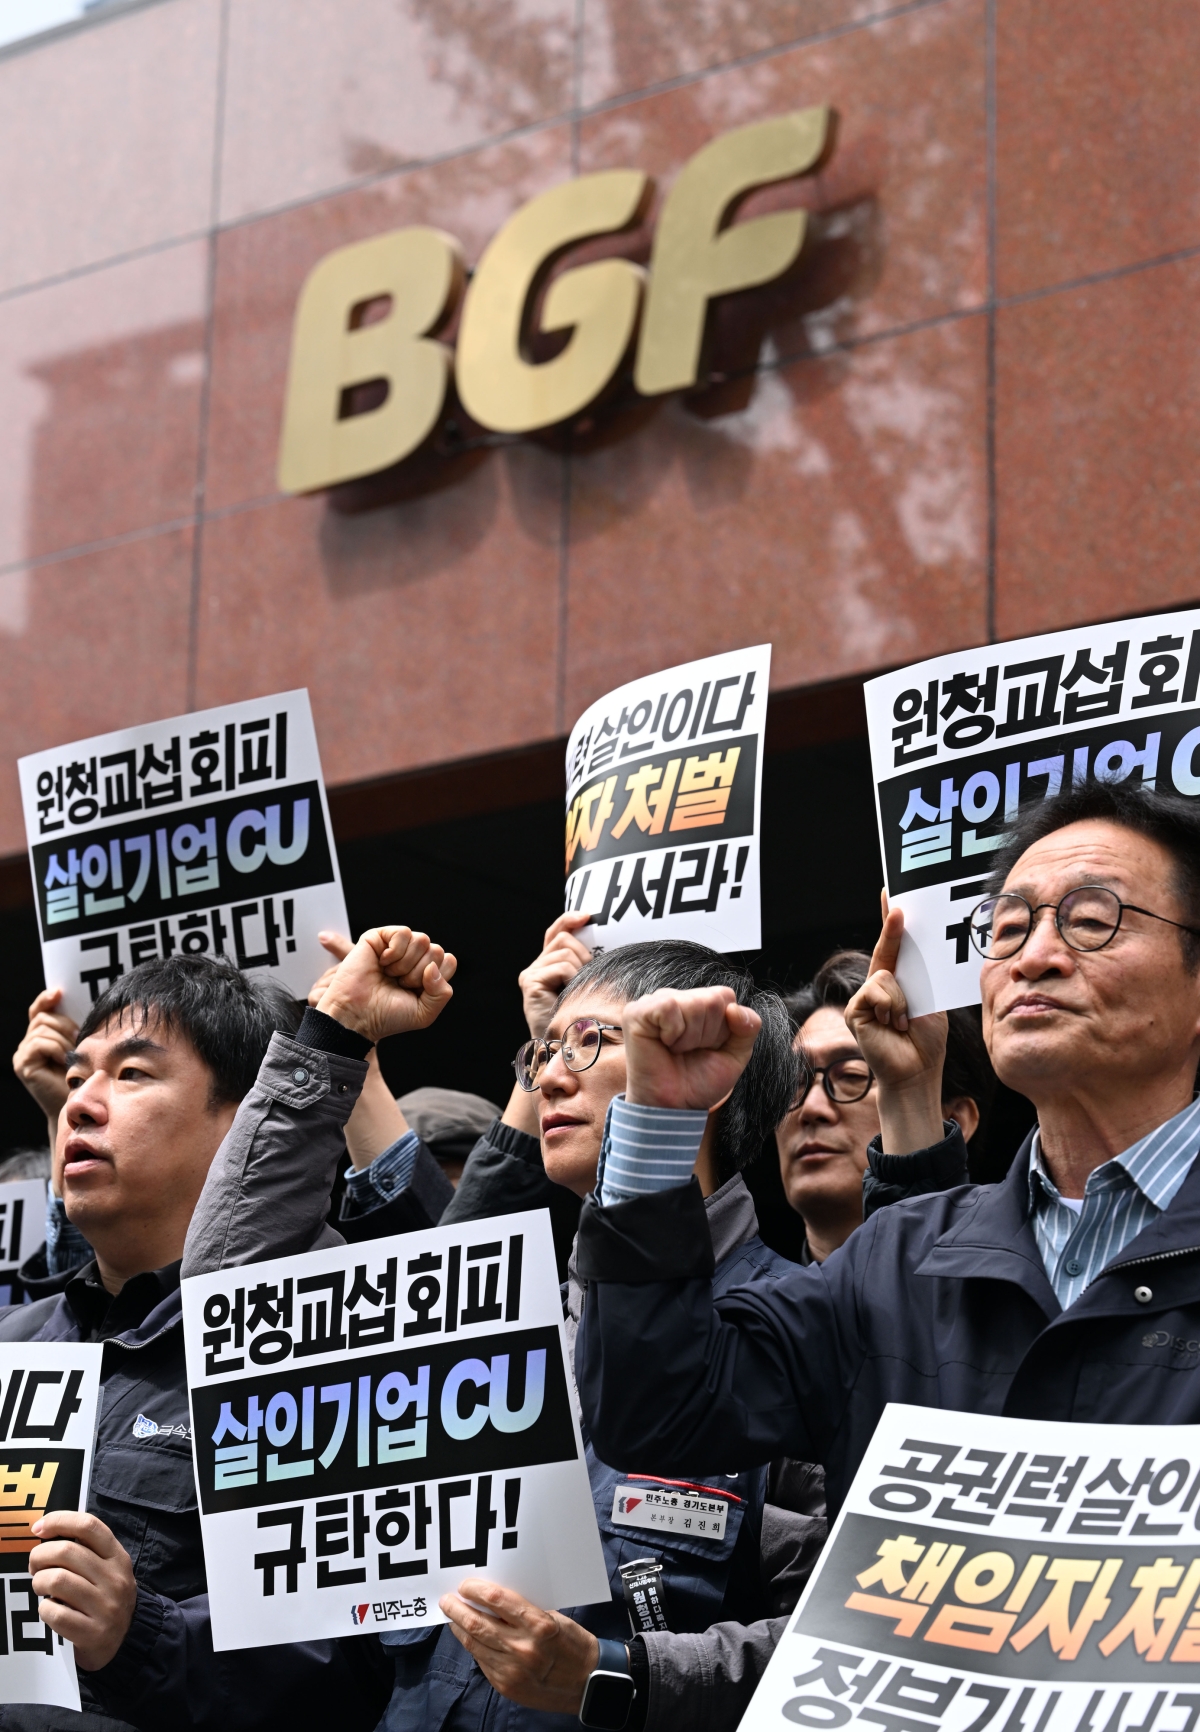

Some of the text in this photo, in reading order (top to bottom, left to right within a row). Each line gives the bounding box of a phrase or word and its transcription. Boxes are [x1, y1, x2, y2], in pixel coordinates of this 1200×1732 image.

[277, 104, 839, 495] BGF
[587, 671, 756, 775] 살인이다
[891, 639, 1130, 768] 원청교섭
[36, 711, 288, 835] 원청교섭 회피
[610, 746, 741, 840] 처벌
[44, 797, 311, 925] 살인기업 CU
[203, 1234, 524, 1376] 원청교섭 회피
[211, 1348, 547, 1490] 살인기업 CU
[254, 1474, 522, 1597] 규탄한다!
[645, 1493, 725, 1514] 민주노총 경기도본부
[869, 1438, 1089, 1534] 공권력
[372, 1597, 427, 1622] 민주노총
[844, 1534, 1123, 1661] 책임자
